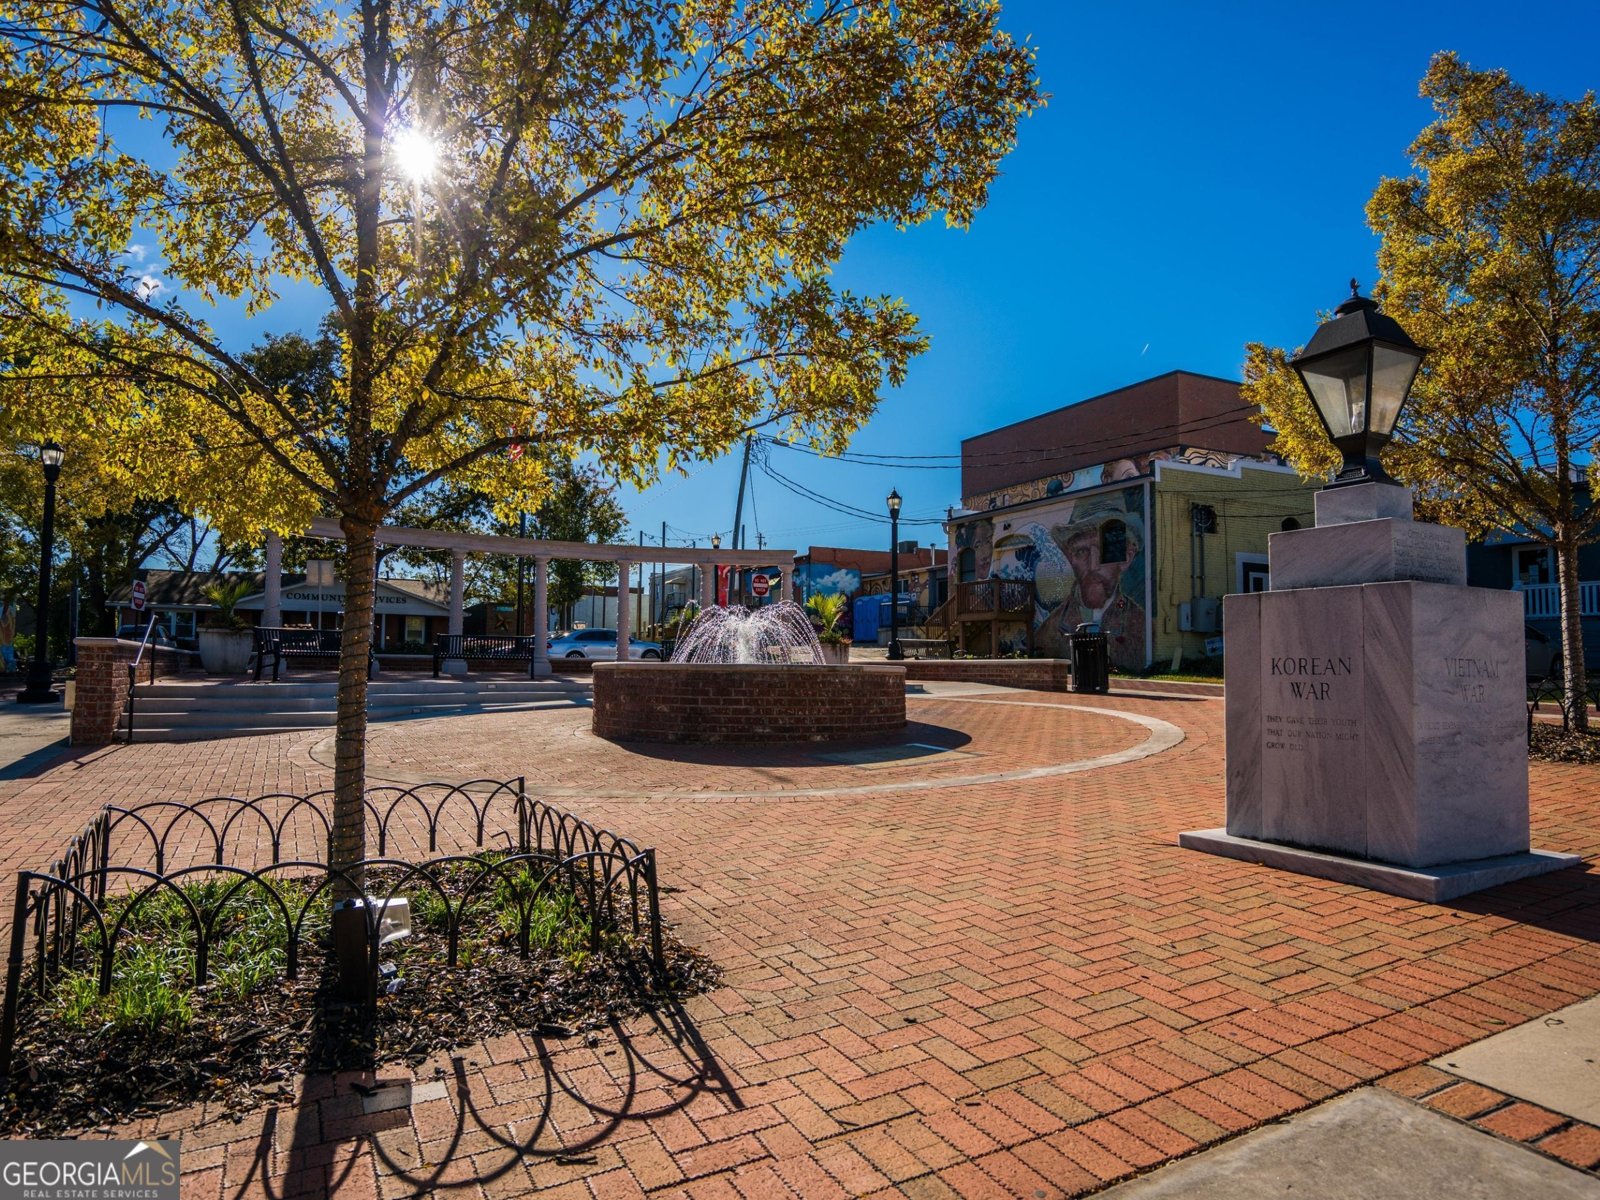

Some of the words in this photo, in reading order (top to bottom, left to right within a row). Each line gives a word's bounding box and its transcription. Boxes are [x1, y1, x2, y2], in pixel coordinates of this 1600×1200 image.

[286, 592, 345, 602] COMMUNI
[1271, 657, 1352, 676] KOREAN
[1444, 657, 1500, 678] VIETNAM
[1290, 682, 1331, 700] WAR
[1461, 684, 1487, 703] WAR
[1266, 715, 1282, 723] THEY
[1332, 719, 1357, 727] YOUTH
[1267, 729, 1283, 737] THAT
[1266, 742, 1286, 750] GROW
